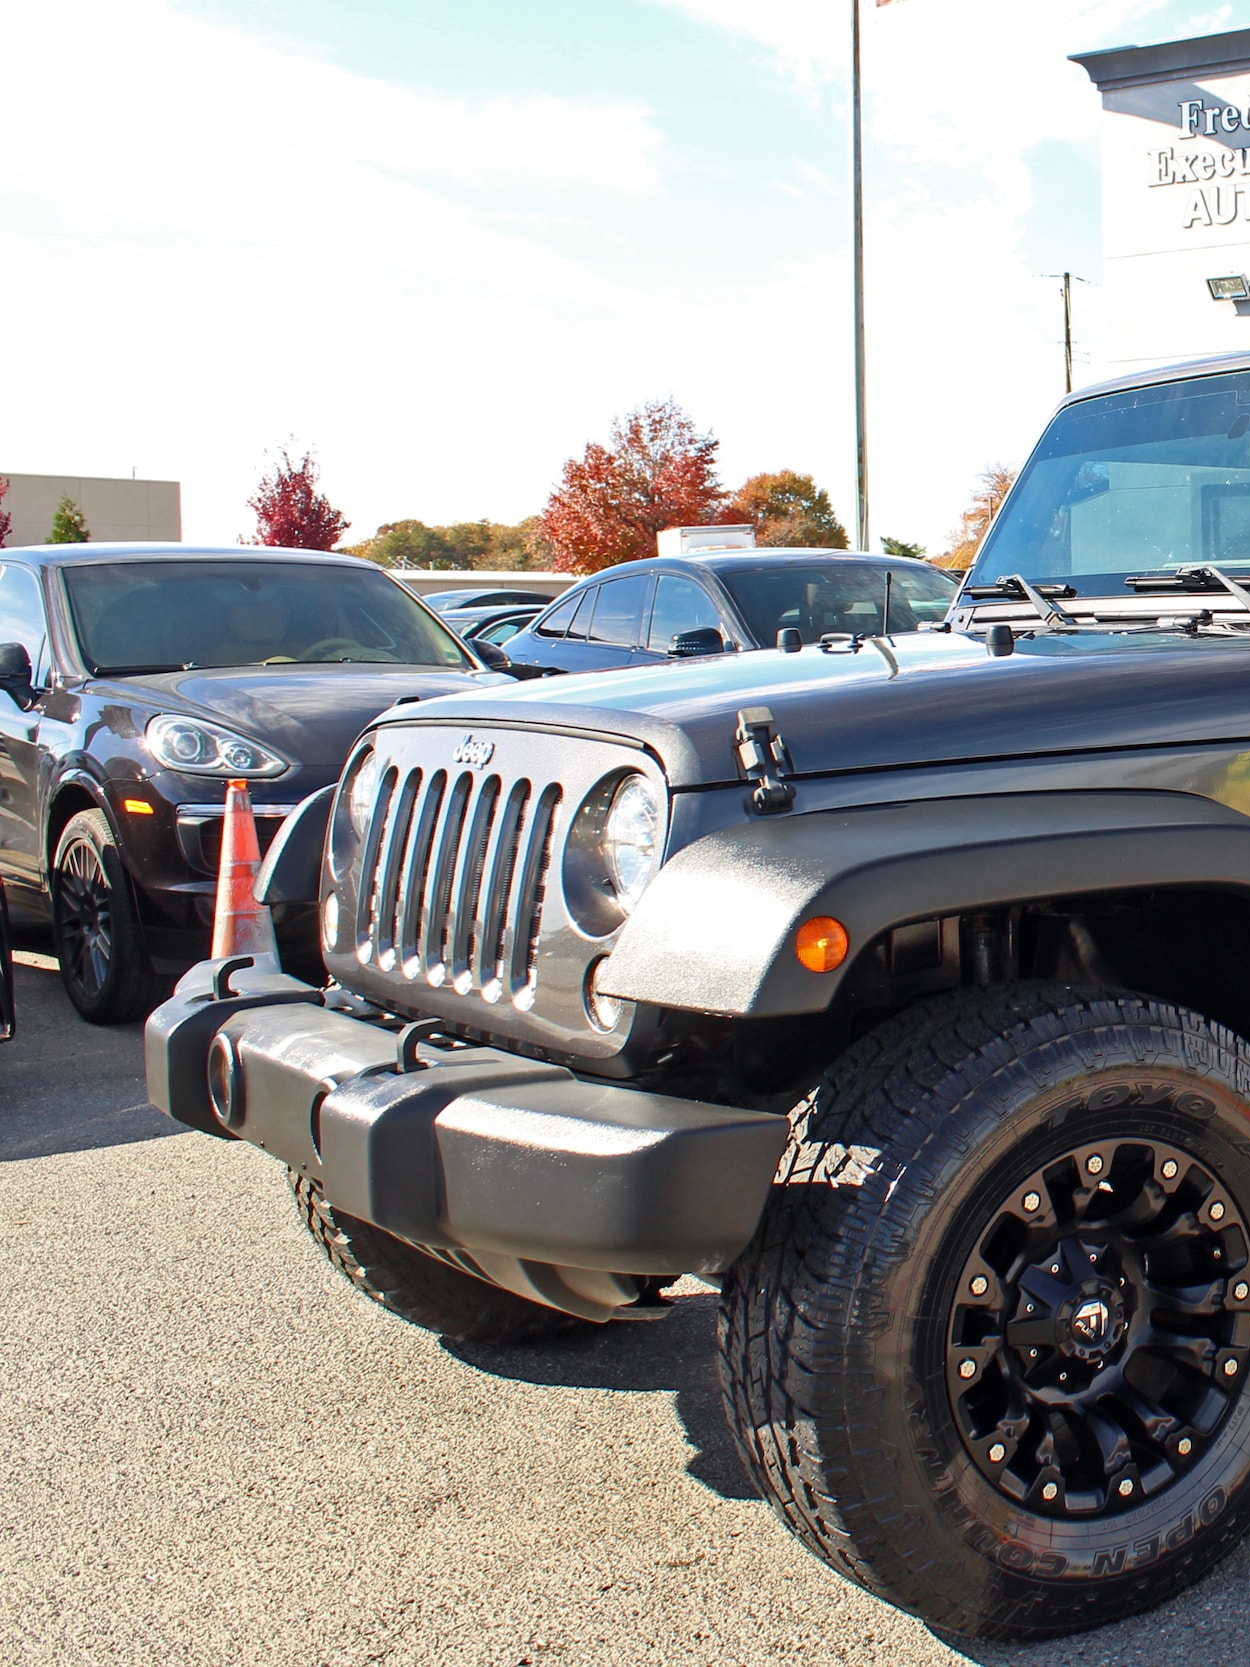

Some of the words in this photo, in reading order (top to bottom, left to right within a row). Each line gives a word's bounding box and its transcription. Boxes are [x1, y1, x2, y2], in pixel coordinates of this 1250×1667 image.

[453, 734, 496, 770] Jeep
[1040, 1082, 1218, 1130] TOYO
[1088, 1484, 1226, 1578] OPEN
